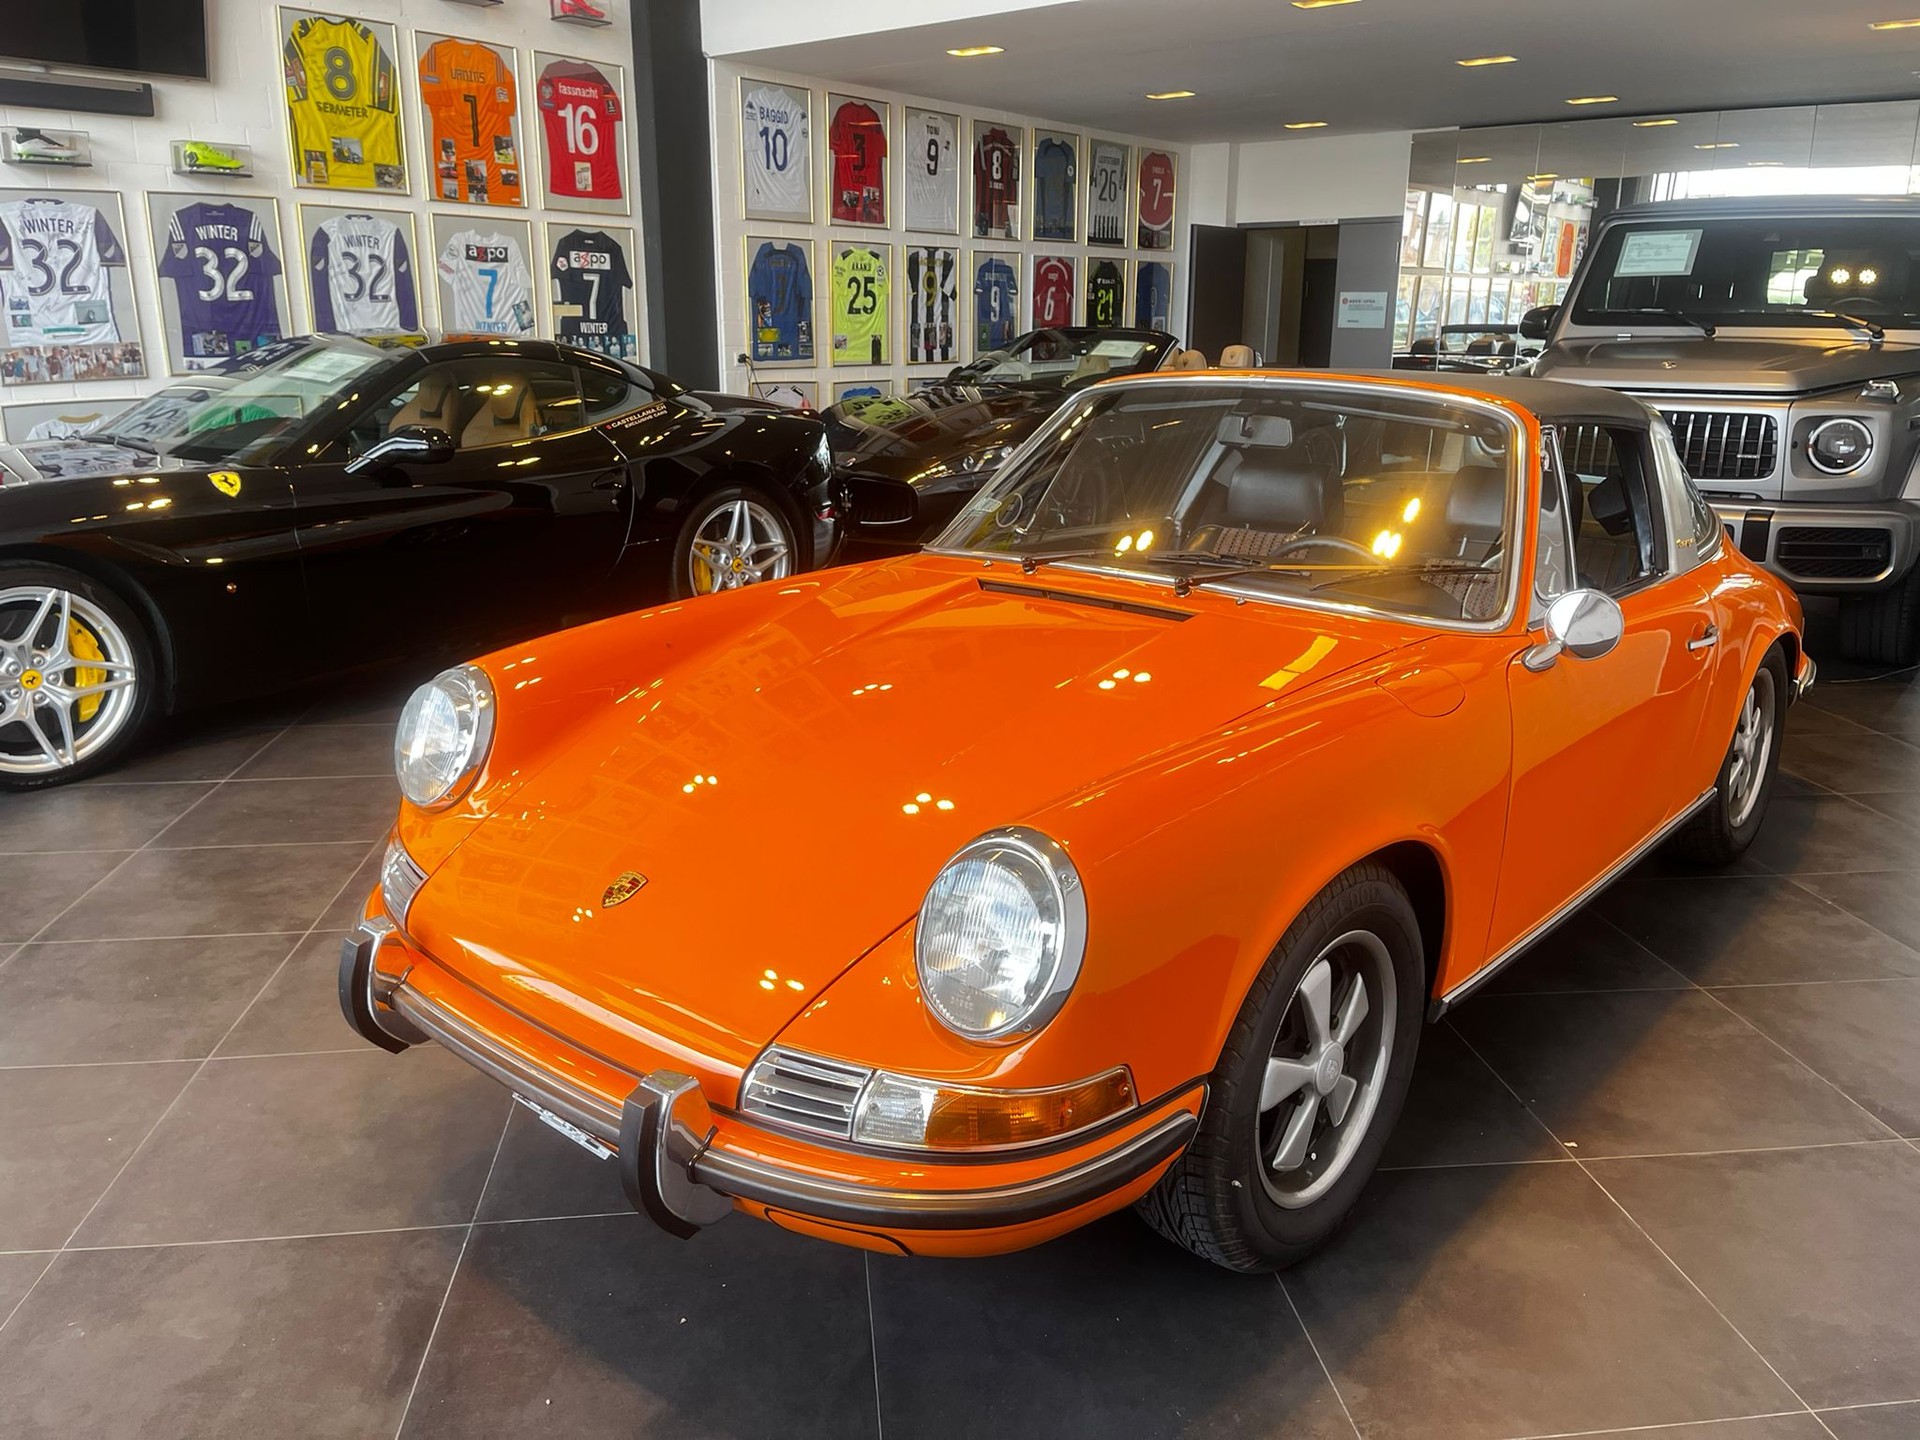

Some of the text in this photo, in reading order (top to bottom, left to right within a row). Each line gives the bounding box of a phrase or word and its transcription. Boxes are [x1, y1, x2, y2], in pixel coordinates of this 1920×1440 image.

[324, 45, 357, 101] 8
[315, 101, 369, 119] SERMETER
[463, 94, 480, 147] 1
[759, 106, 789, 125] BAGGIO
[557, 102, 599, 155] 16
[759, 126, 788, 172] 10
[926, 138, 939, 176] 9
[992, 150, 1002, 180] 8
[1098, 168, 1117, 202] 26
[1153, 178, 1162, 210] 7
[24, 218, 74, 235] WINTER
[195, 224, 239, 242] WINTER
[344, 235, 380, 251] WINTER
[21, 238, 90, 297] 32
[194, 246, 255, 302] 32
[339, 251, 391, 303] 32
[478, 268, 498, 319] 7
[582, 273, 602, 319] 7
[847, 276, 877, 315] 25
[922, 270, 938, 307] 9
[990, 285, 1000, 322] 9
[1044, 286, 1056, 321] 6
[1096, 288, 1113, 321] 21
[475, 320, 508, 332] WINTER
[580, 321, 608, 335] WINTER
[611, 405, 667, 428] CASTELLANA.CH
